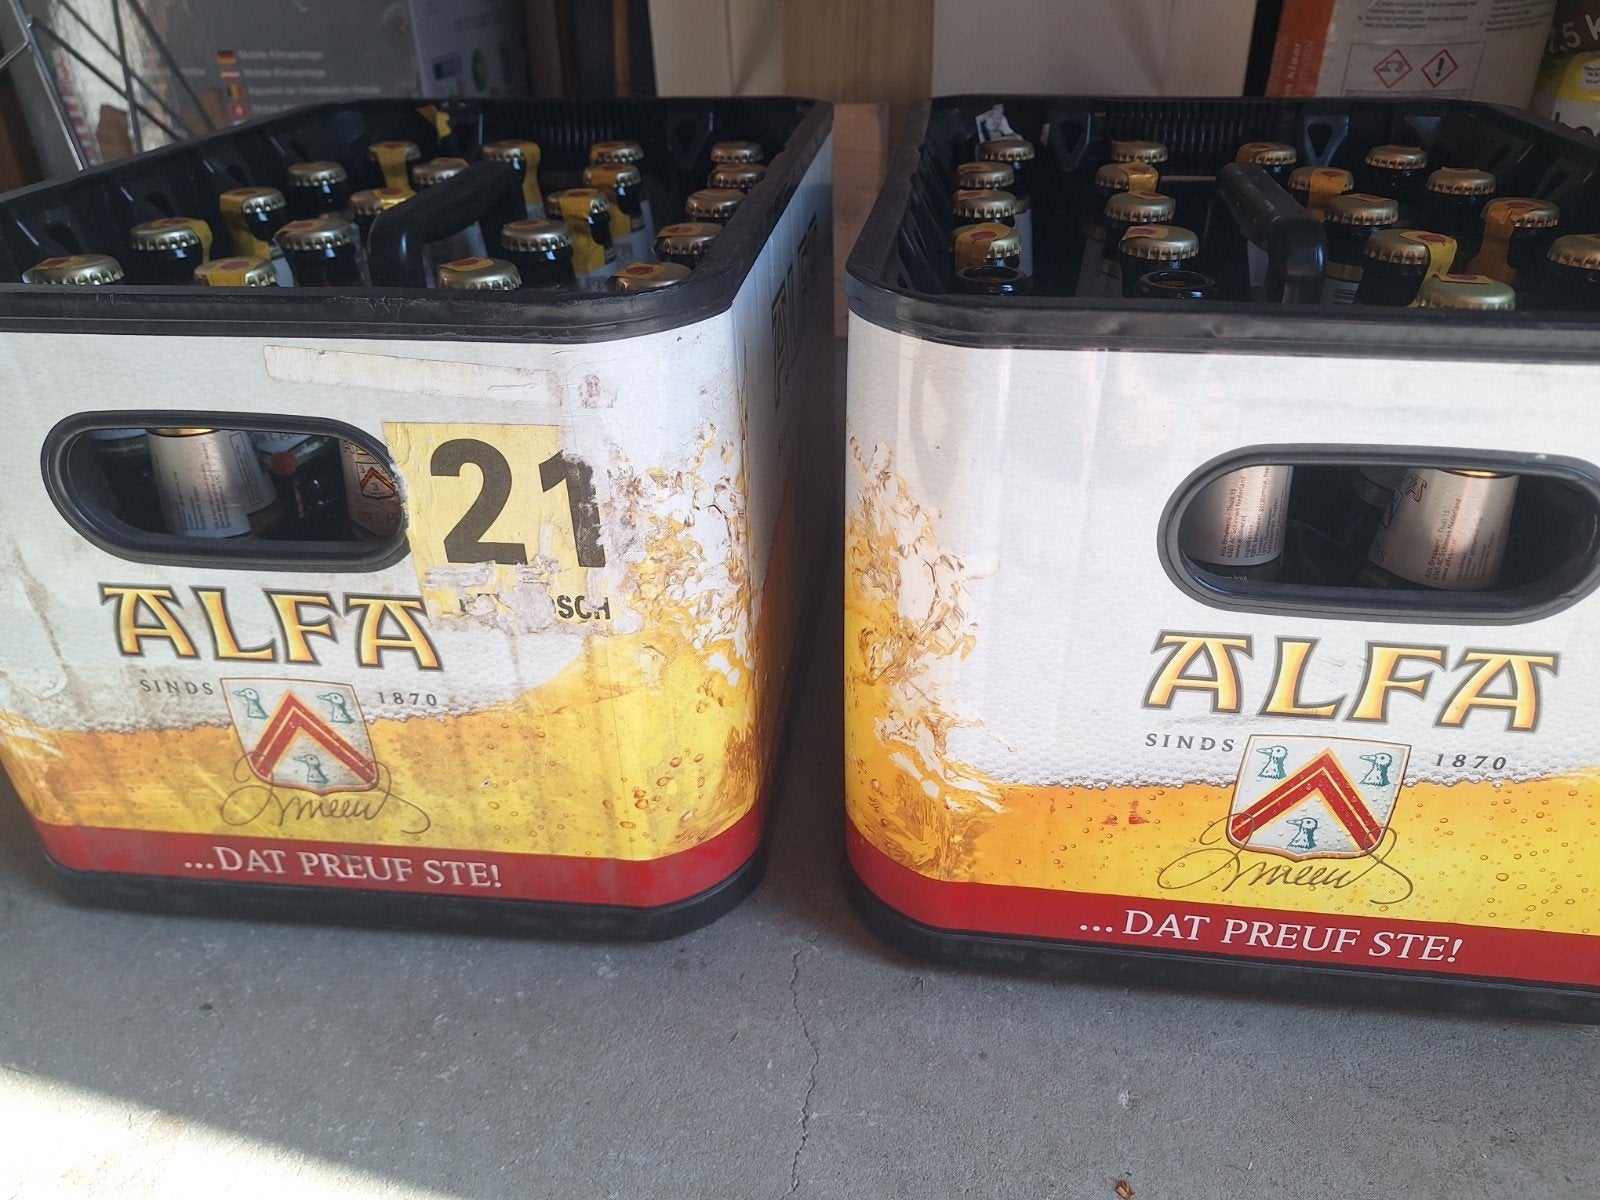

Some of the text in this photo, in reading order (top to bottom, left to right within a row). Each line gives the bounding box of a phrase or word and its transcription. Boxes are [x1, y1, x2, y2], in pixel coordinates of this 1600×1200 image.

[430, 438, 606, 568] 21
[97, 582, 444, 671] ALFA
[139, 679, 215, 696] SINDS
[376, 691, 438, 707] 1870
[1141, 629, 1562, 733] ALFA
[1145, 733, 1236, 753] SINDS
[1433, 752, 1508, 771] 1870
[296, 851, 413, 882] PREUF
[423, 859, 503, 888] STE!
[1220, 918, 1361, 954] PREUF
[1367, 931, 1464, 963] STE!
